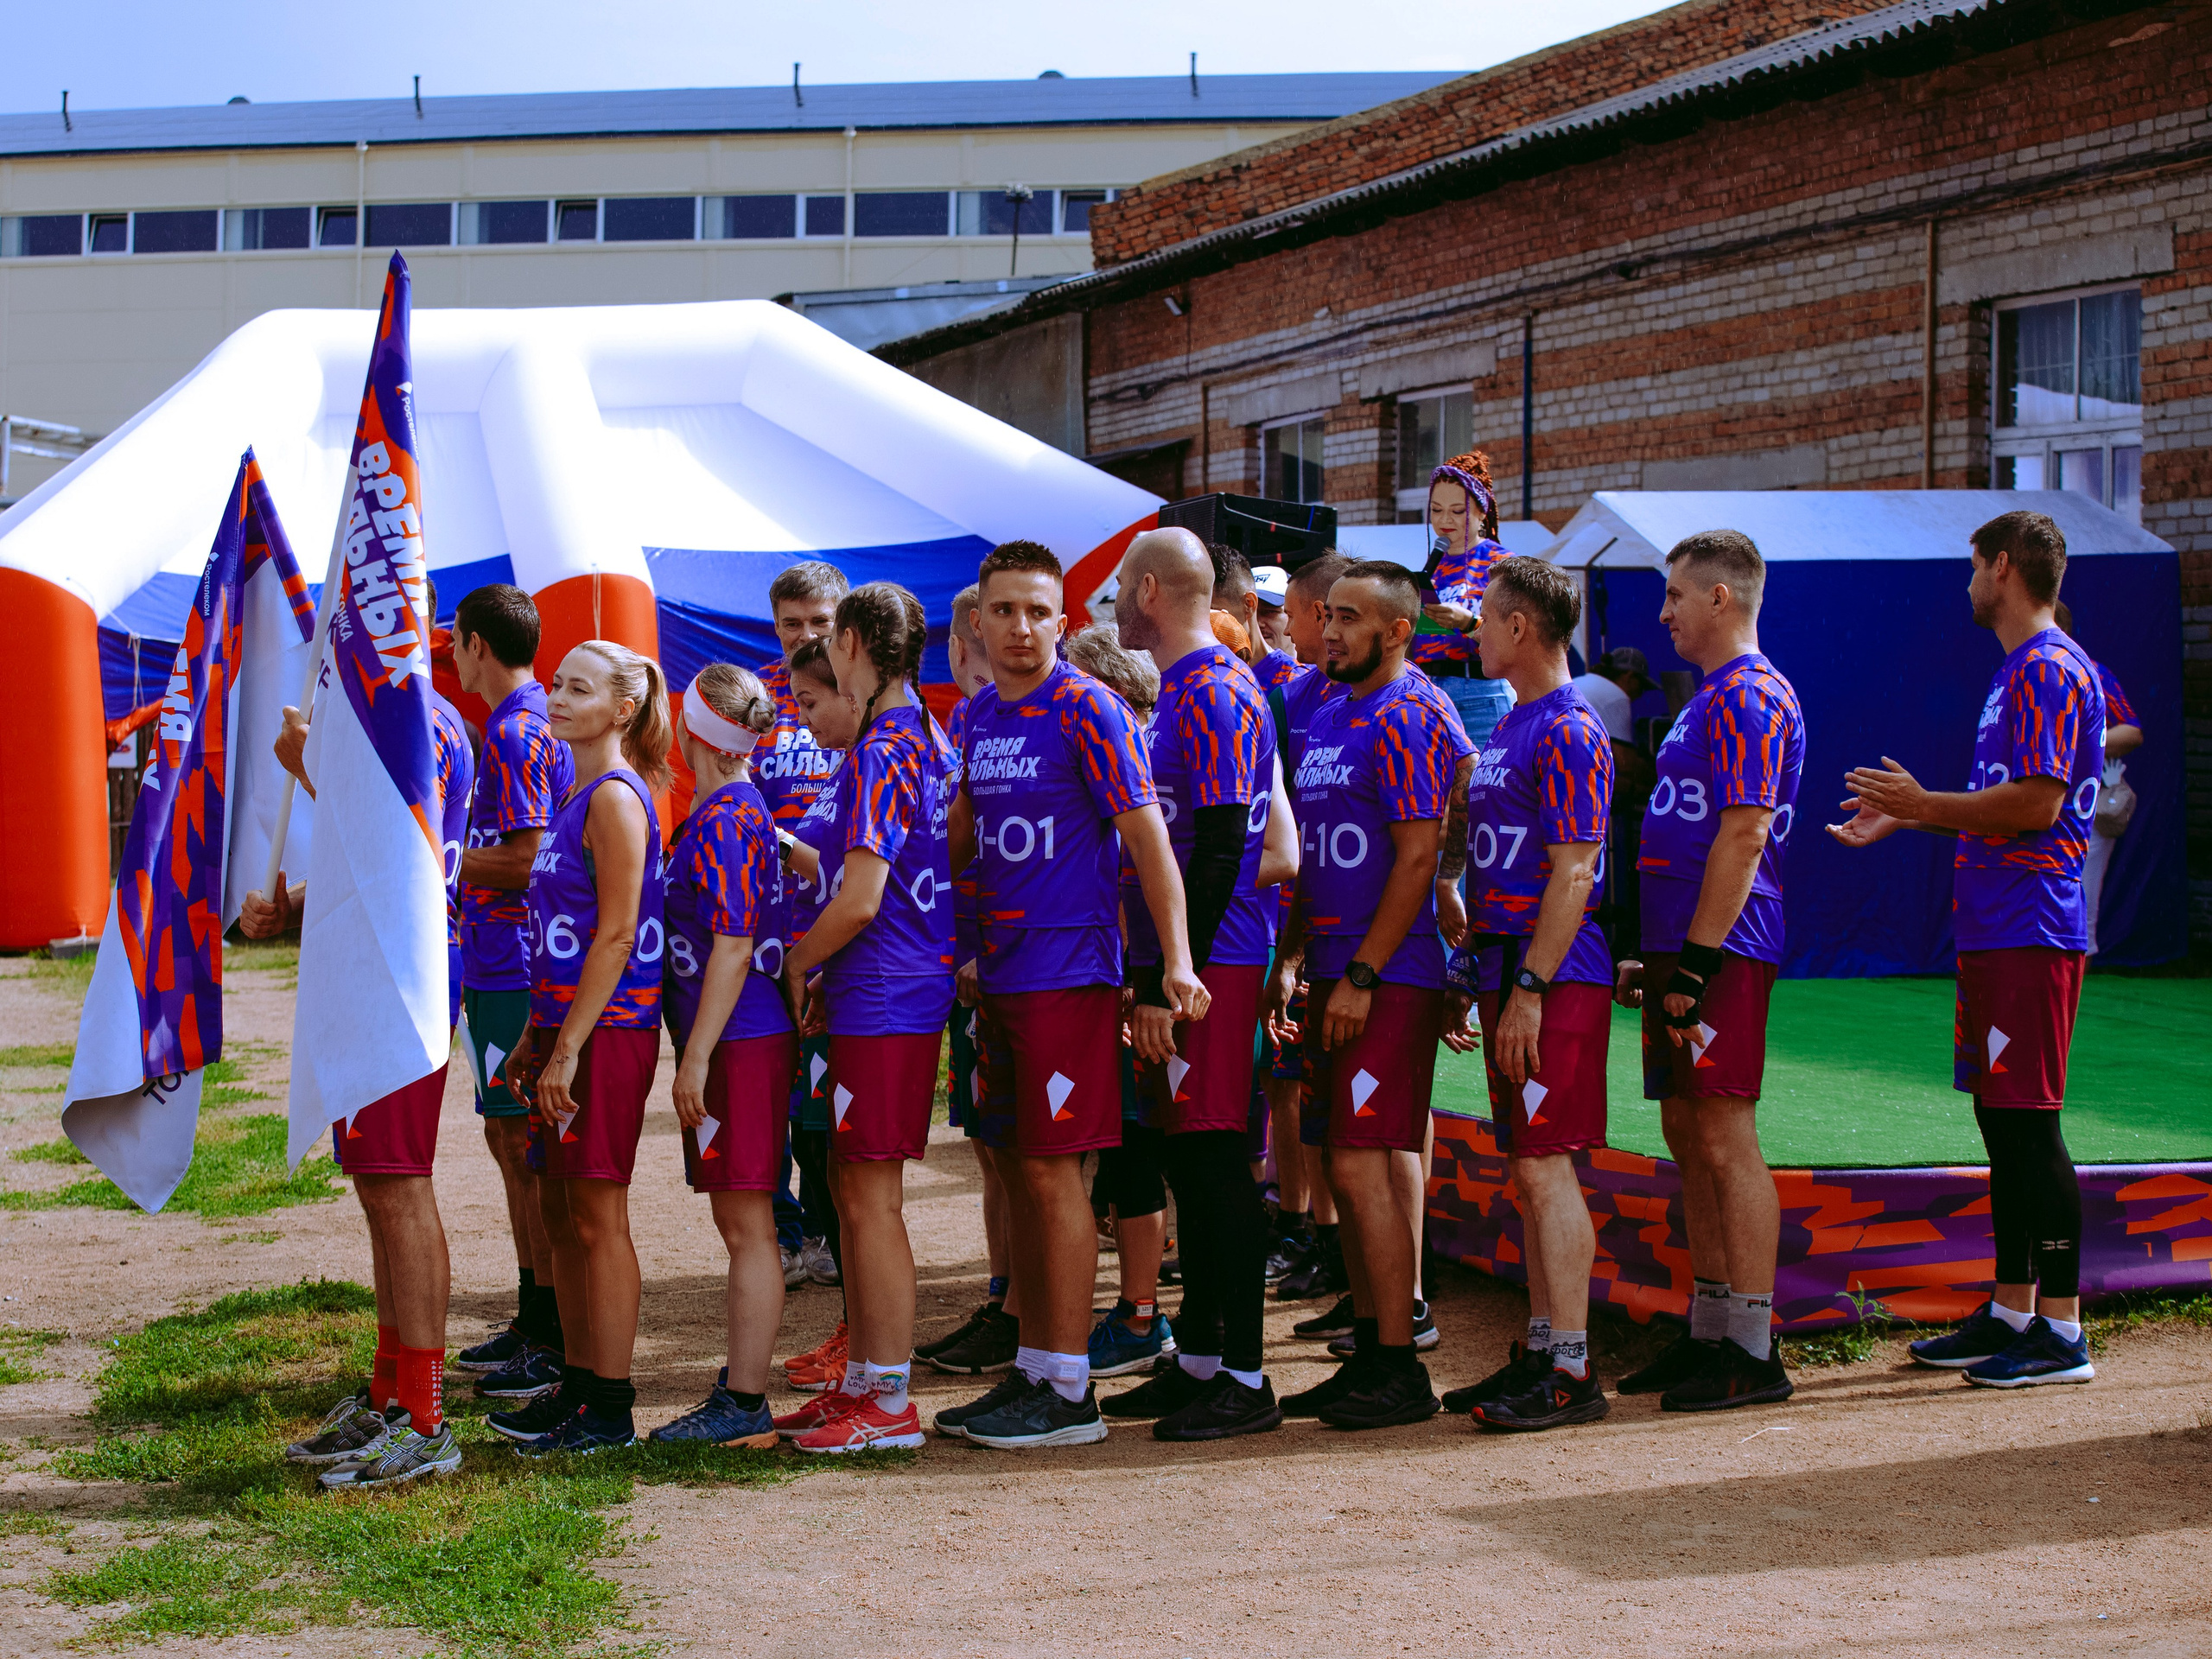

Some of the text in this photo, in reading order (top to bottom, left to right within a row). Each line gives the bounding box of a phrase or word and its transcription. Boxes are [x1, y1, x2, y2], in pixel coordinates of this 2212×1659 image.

[358, 441, 429, 617] ВРЕМЯ
[203, 563, 213, 616] Ростелеком
[346, 479, 430, 689] ЛЬНЫХ
[972, 736, 1027, 761] ВРЕМЯ
[973, 784, 1012, 796] БОЛЬШАЯ ГОНКА
[973, 814, 1054, 862] 1-01
[1698, 1288, 1730, 1299] FILA
[1747, 1299, 1772, 1308] FIL
